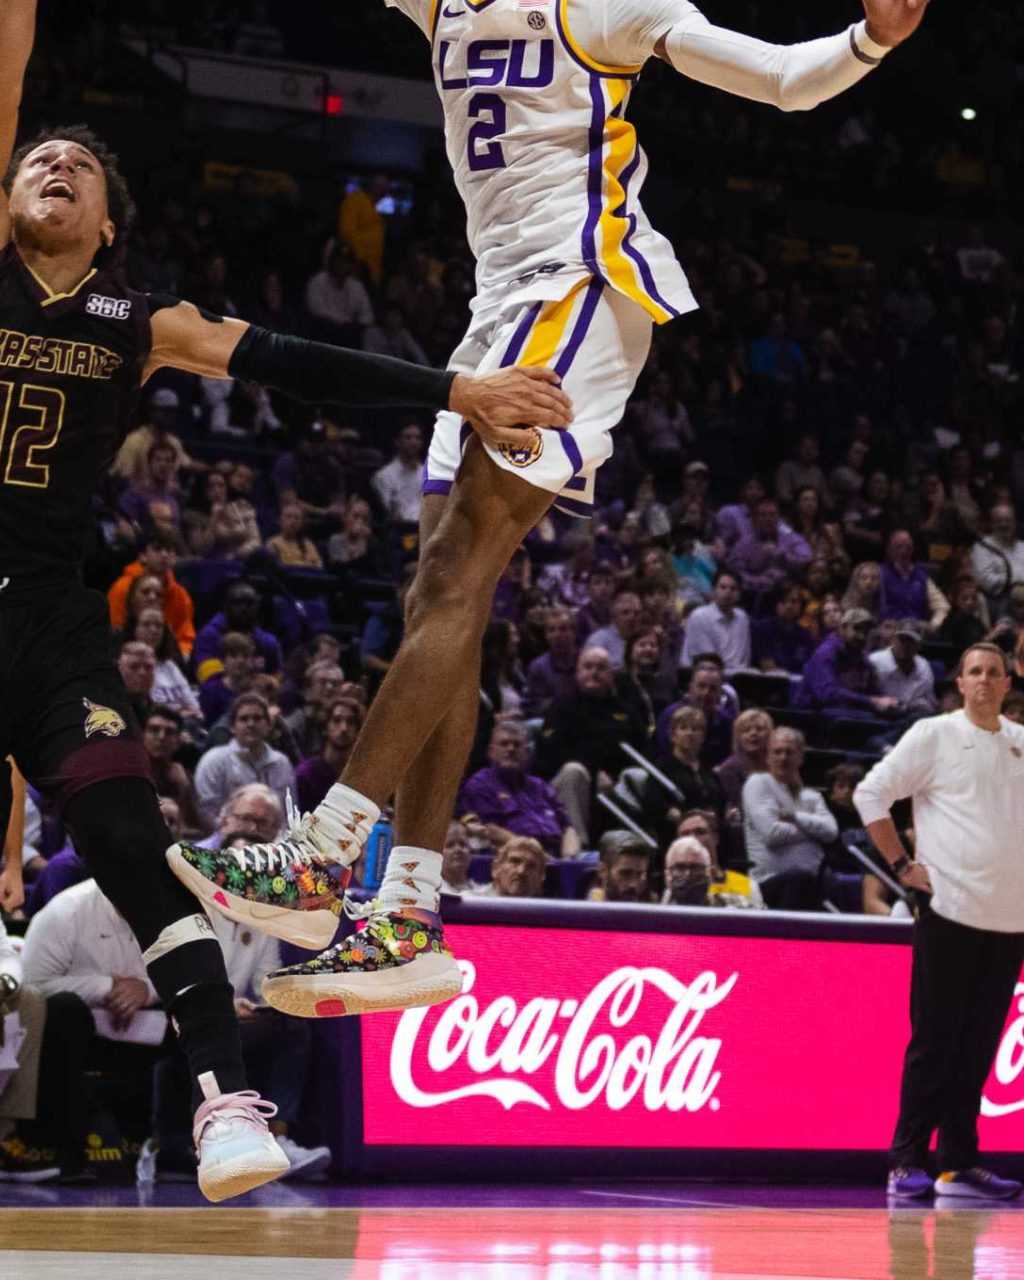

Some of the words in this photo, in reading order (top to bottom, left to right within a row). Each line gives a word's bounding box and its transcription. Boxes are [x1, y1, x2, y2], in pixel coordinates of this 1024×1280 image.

[440, 39, 554, 90] LSU
[467, 93, 507, 172] 2
[86, 293, 132, 320] SBC
[389, 959, 739, 1112] Coca-Cola
